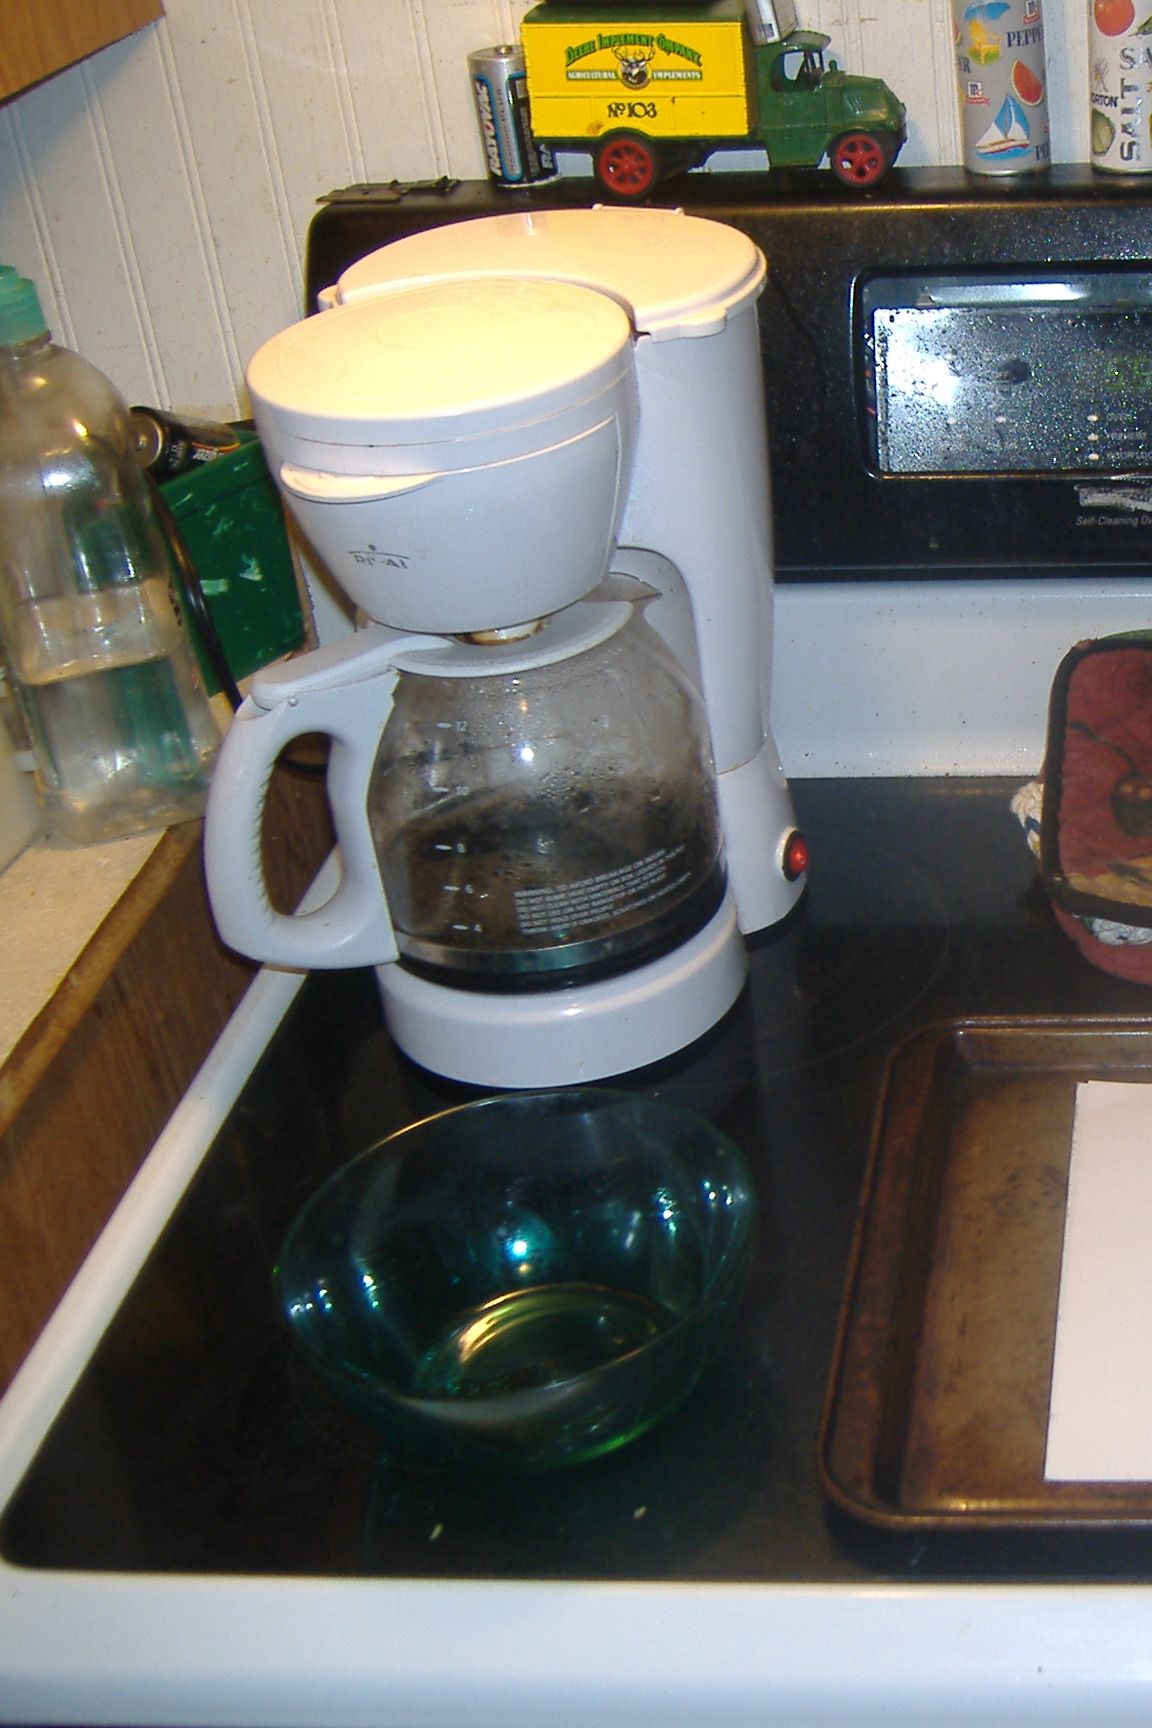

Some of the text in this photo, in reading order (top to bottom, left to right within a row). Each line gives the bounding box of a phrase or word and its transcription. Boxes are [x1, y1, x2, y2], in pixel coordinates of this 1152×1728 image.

[597, 32, 655, 51] IMPLEMENT
[1006, 27, 1044, 48] PEPP
[567, 70, 702, 80] AGRICULTURAL IMPLEMENTS
[1090, 92, 1119, 108] ORTON
[627, 102, 657, 118] 103
[1120, 77, 1142, 161] SALT
[475, 80, 503, 177] RAYOVAC
[1075, 516, 1138, 528] Self-Cleaning
[456, 721, 468, 732] 12
[465, 884, 473, 894] 6
[474, 924, 483, 933] 4
